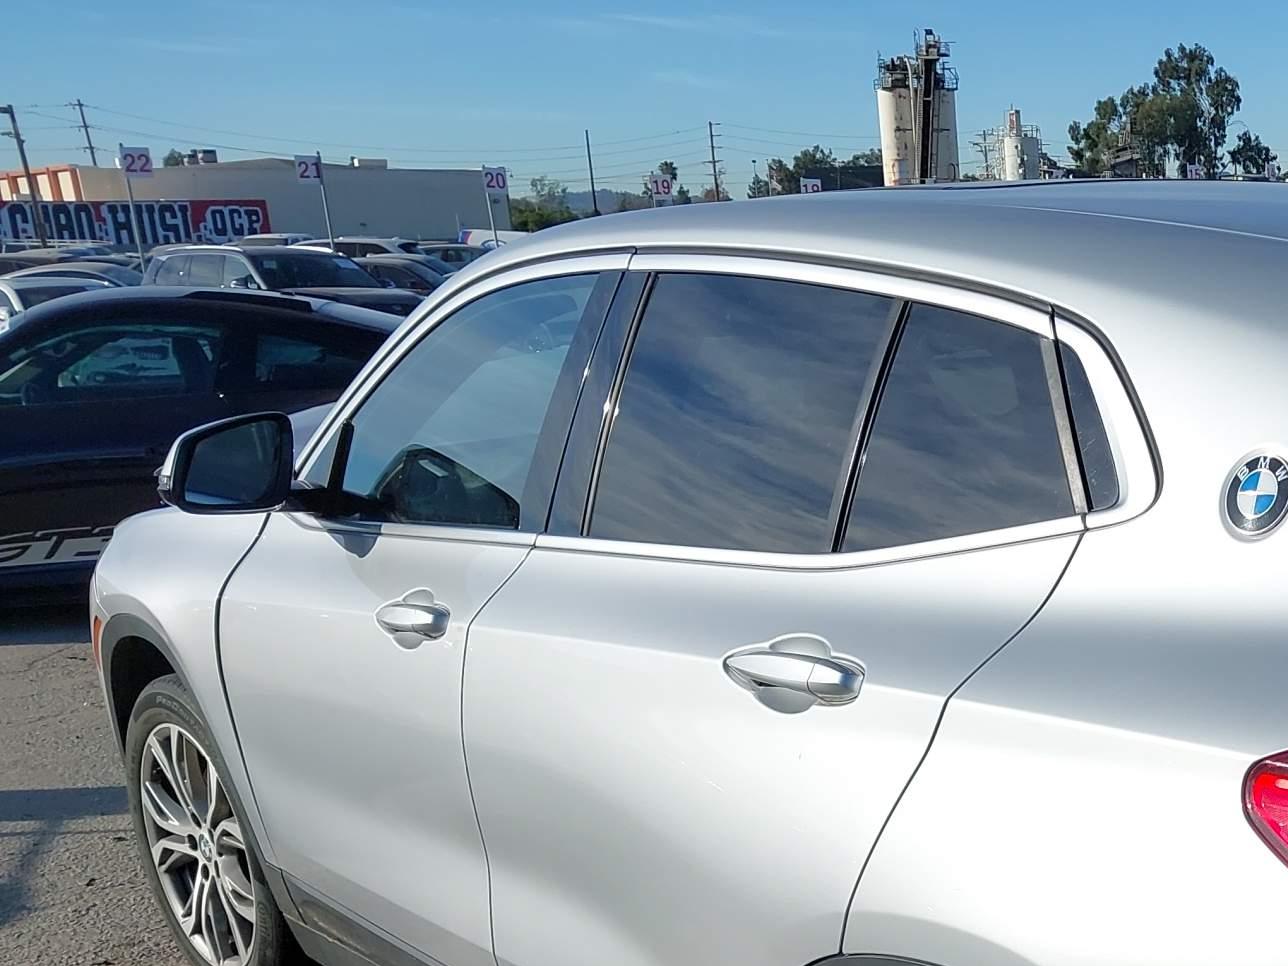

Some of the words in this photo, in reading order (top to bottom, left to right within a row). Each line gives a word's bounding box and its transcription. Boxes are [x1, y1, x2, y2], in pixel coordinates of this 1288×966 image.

[124, 153, 152, 172] 22
[298, 161, 321, 178] 21
[485, 172, 506, 188] 20
[653, 179, 670, 194] 19
[1238, 456, 1288, 482] BMW
